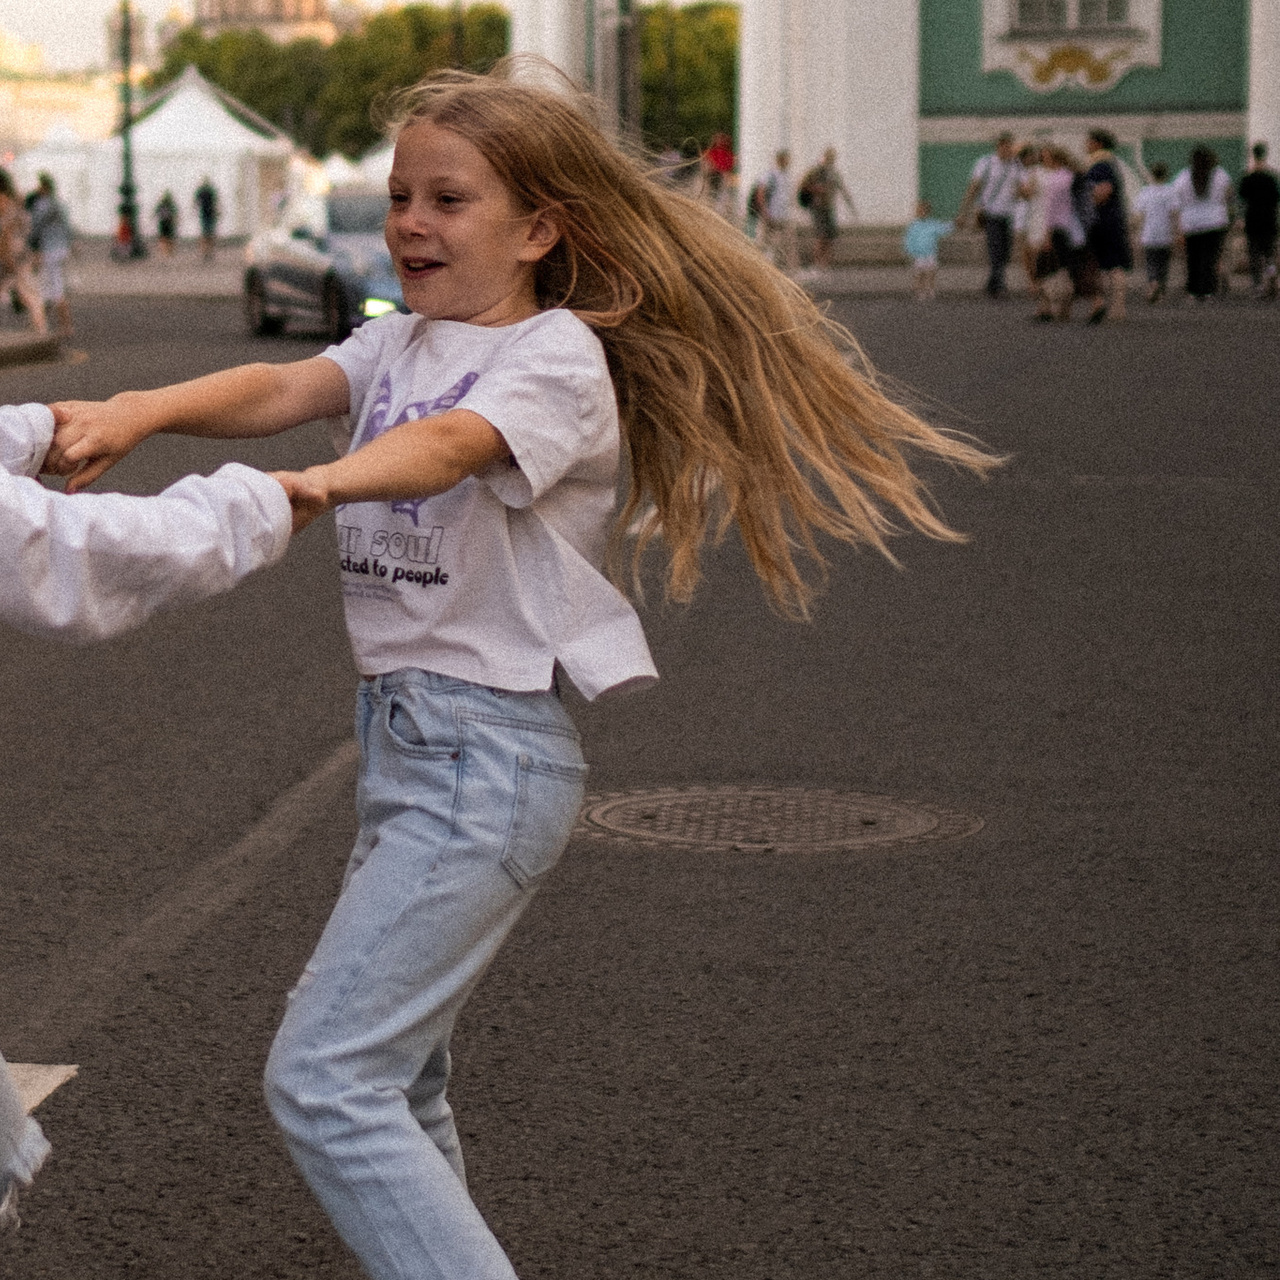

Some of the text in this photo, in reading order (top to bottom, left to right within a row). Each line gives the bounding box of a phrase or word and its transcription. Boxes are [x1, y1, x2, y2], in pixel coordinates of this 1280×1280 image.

[370, 525, 445, 565] soul
[372, 558, 388, 578] to
[391, 566, 449, 588] people
